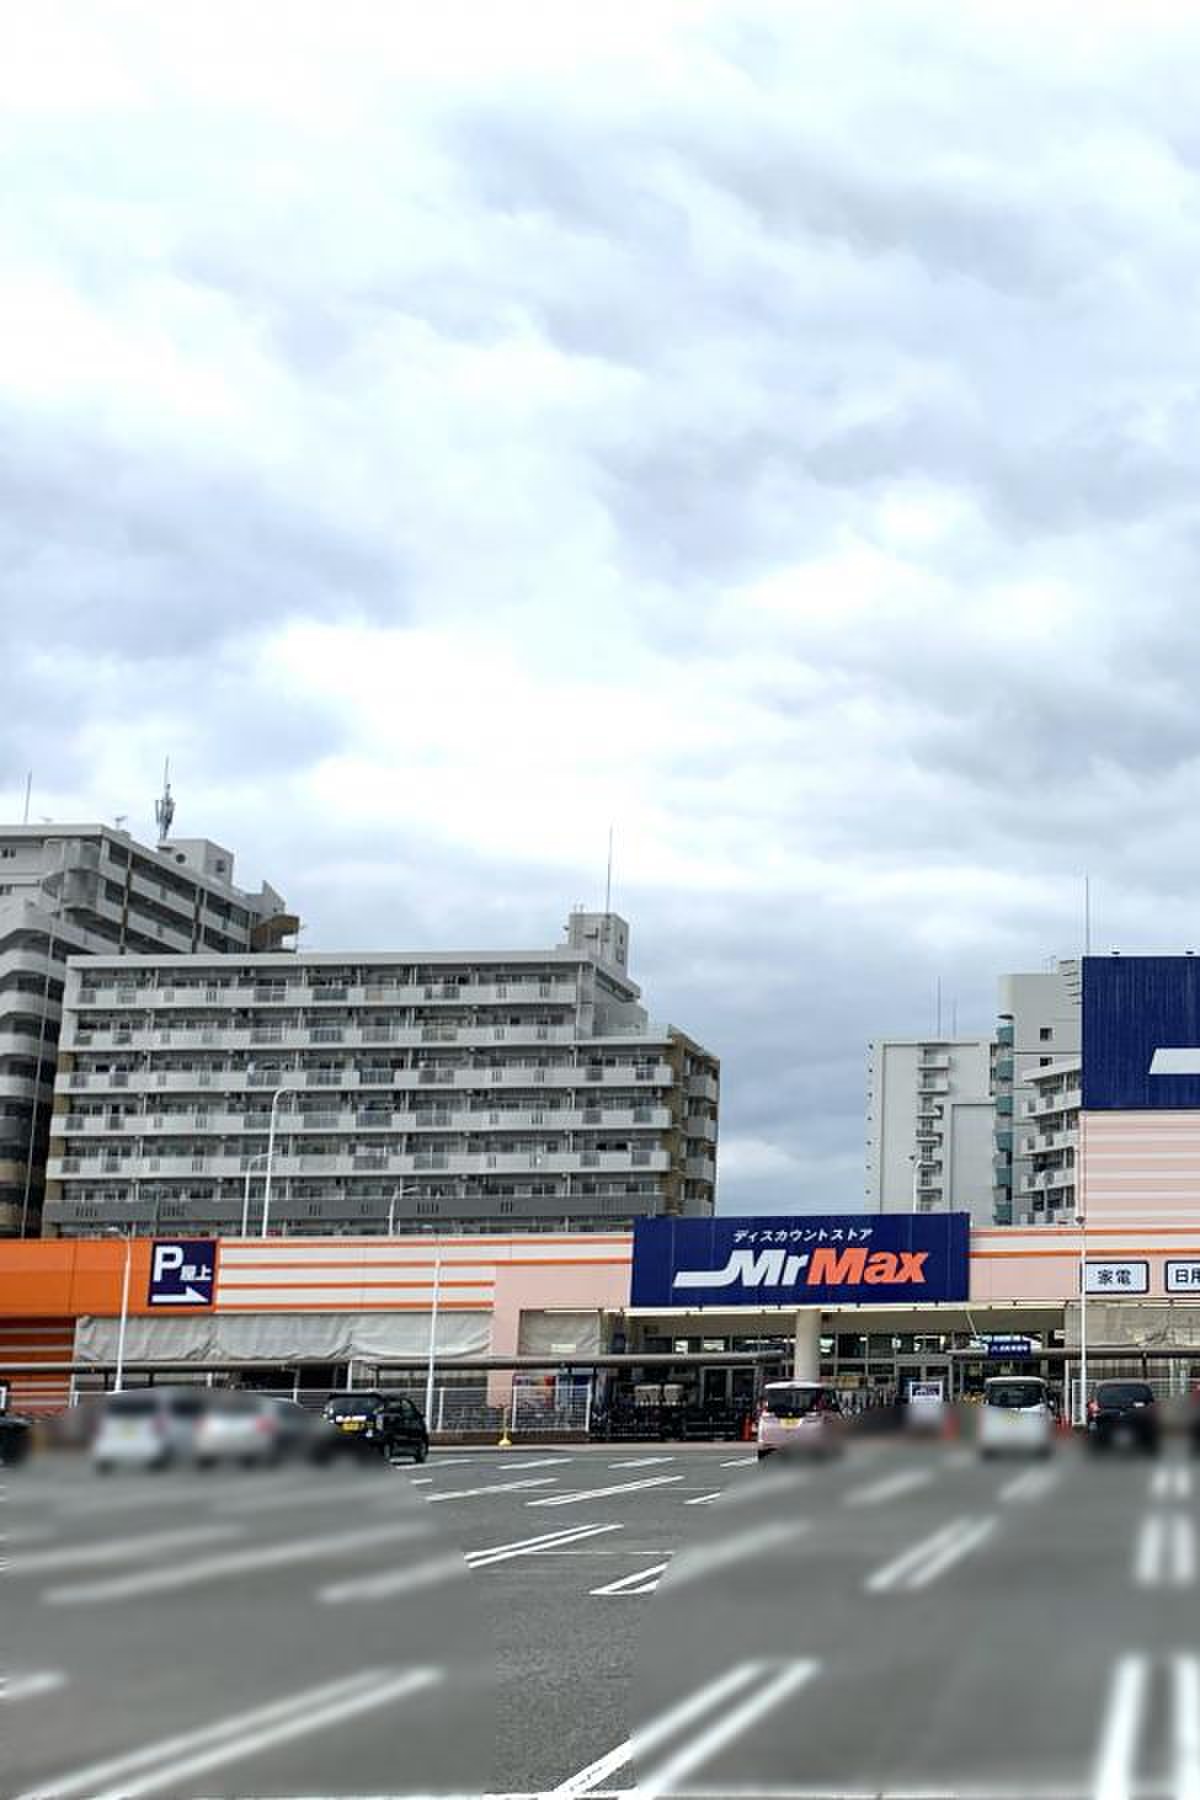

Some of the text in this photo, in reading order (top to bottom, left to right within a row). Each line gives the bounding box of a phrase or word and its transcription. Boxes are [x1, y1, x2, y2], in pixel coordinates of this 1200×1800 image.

[733, 1228, 873, 1243] ディスカウントストア
[153, 1246, 184, 1282] P
[672, 1247, 929, 1288] MrMax
[1097, 1269, 1132, 1285] 家電
